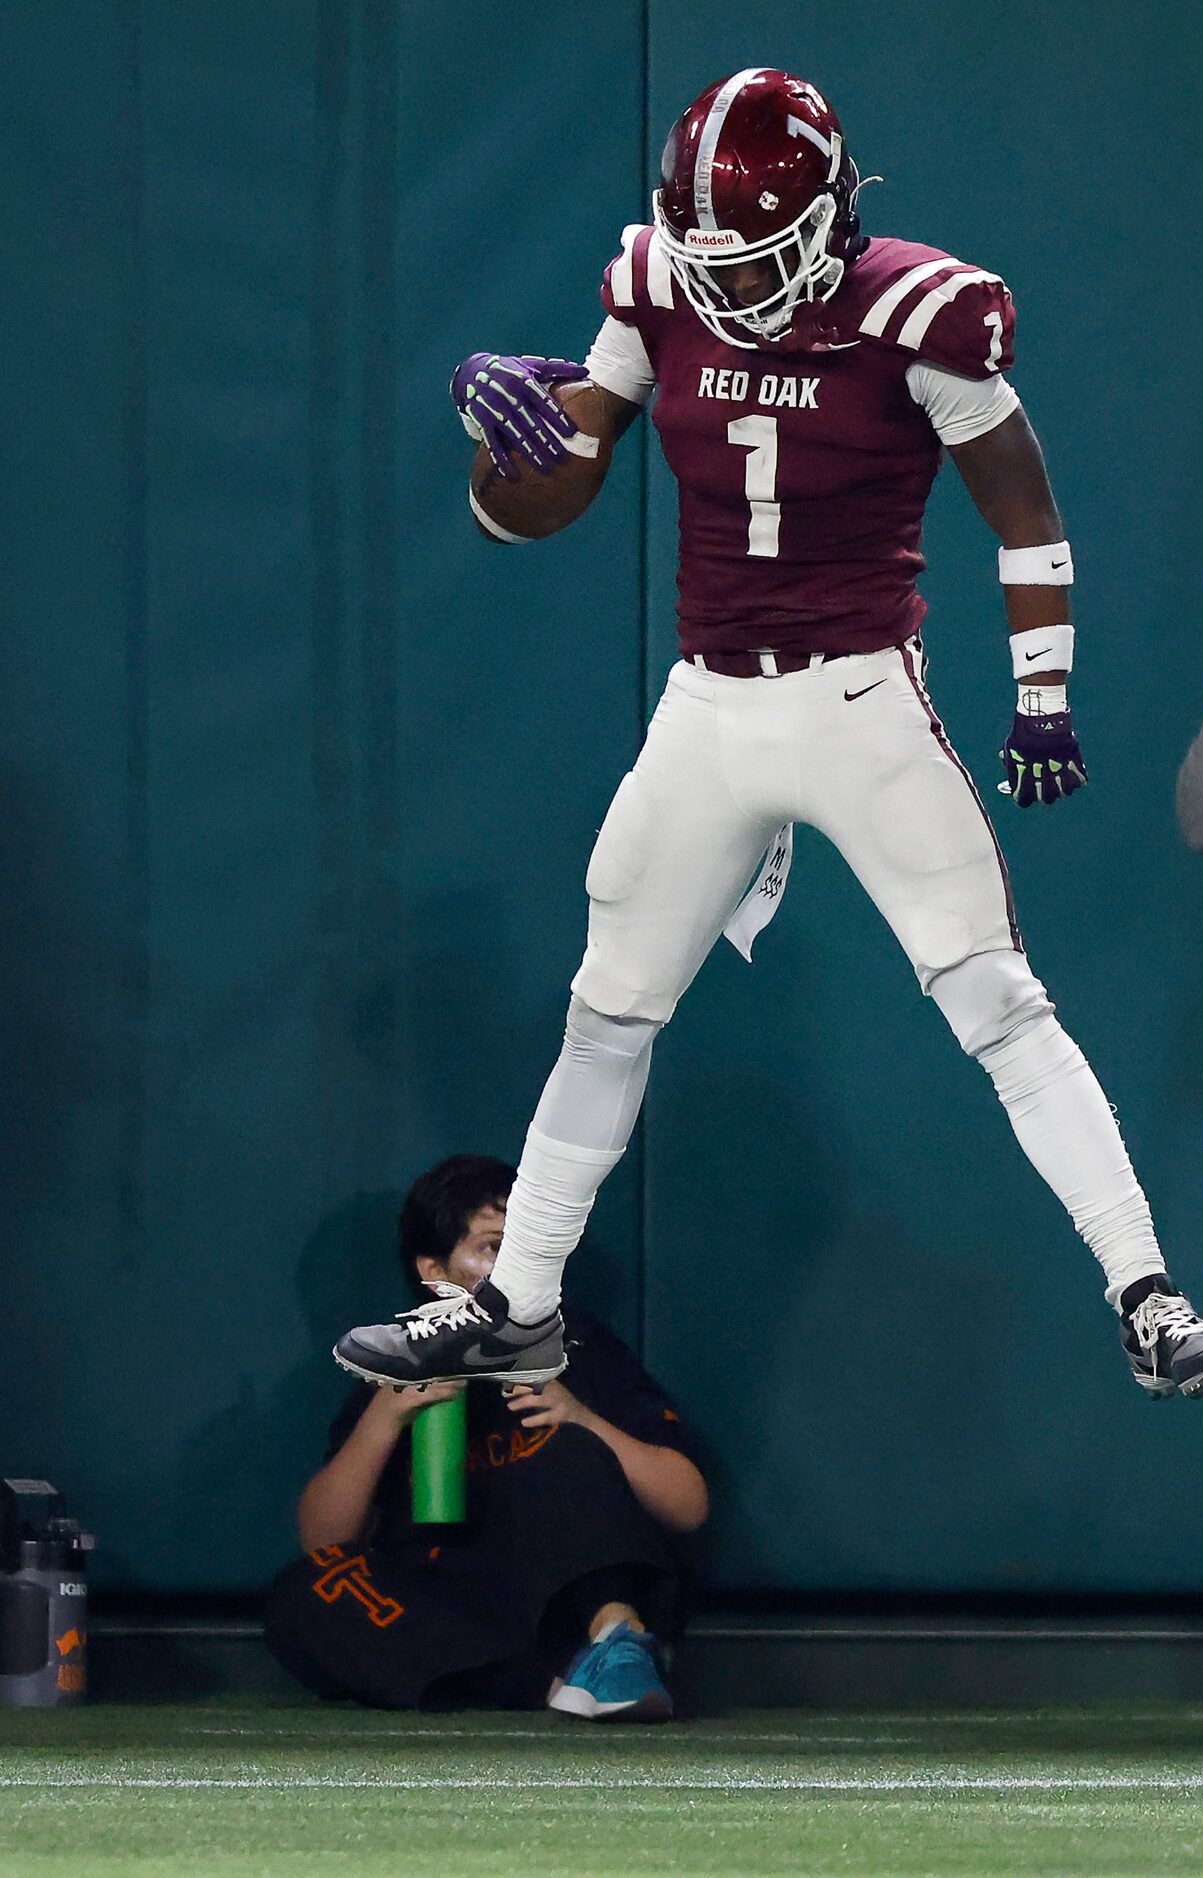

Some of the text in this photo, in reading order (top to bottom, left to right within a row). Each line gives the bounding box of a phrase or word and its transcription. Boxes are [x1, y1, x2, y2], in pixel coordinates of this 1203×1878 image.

[690, 234, 734, 246] Riddell
[983, 311, 1003, 372] 1
[698, 367, 821, 409] RED OAK
[727, 414, 781, 558] 1
